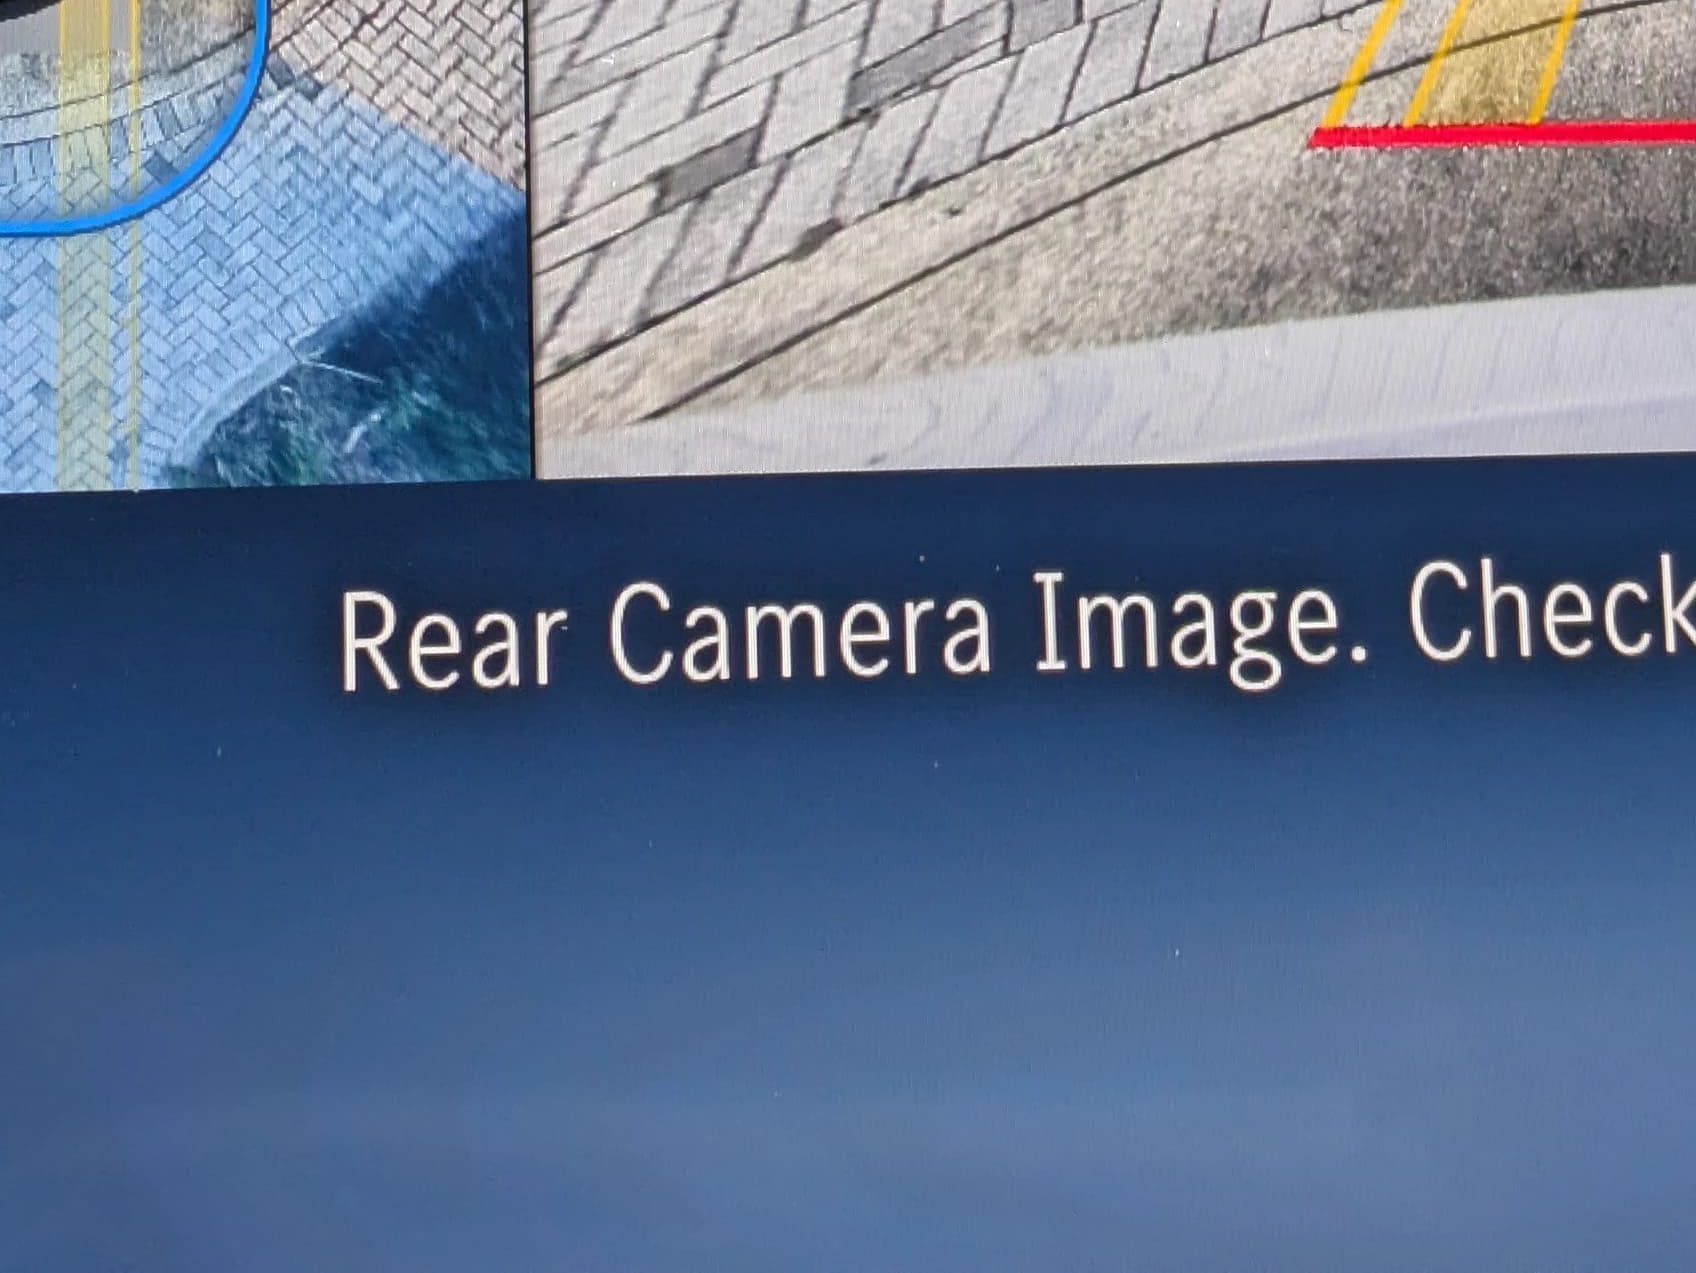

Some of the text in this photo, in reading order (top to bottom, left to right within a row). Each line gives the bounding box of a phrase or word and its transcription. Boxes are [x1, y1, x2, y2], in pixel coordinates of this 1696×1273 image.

[342, 589, 569, 693] Rear
[609, 580, 992, 686] Camera
[1032, 570, 1369, 693] Image.
